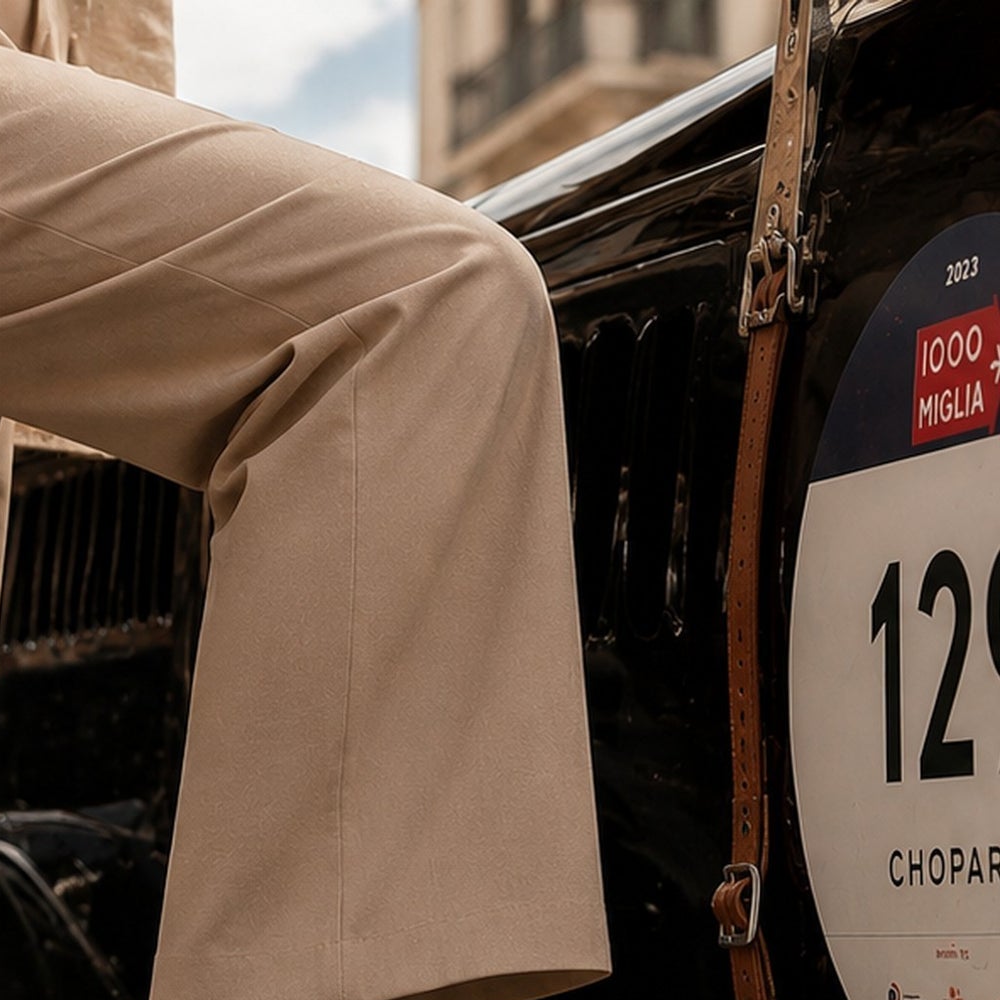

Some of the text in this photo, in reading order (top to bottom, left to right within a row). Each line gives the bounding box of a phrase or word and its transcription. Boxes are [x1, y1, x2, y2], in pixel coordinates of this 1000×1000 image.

[945, 255, 980, 286] 2023
[922, 324, 983, 377] 1000
[918, 380, 985, 429] MIGLIA
[870, 549, 1000, 783] 12
